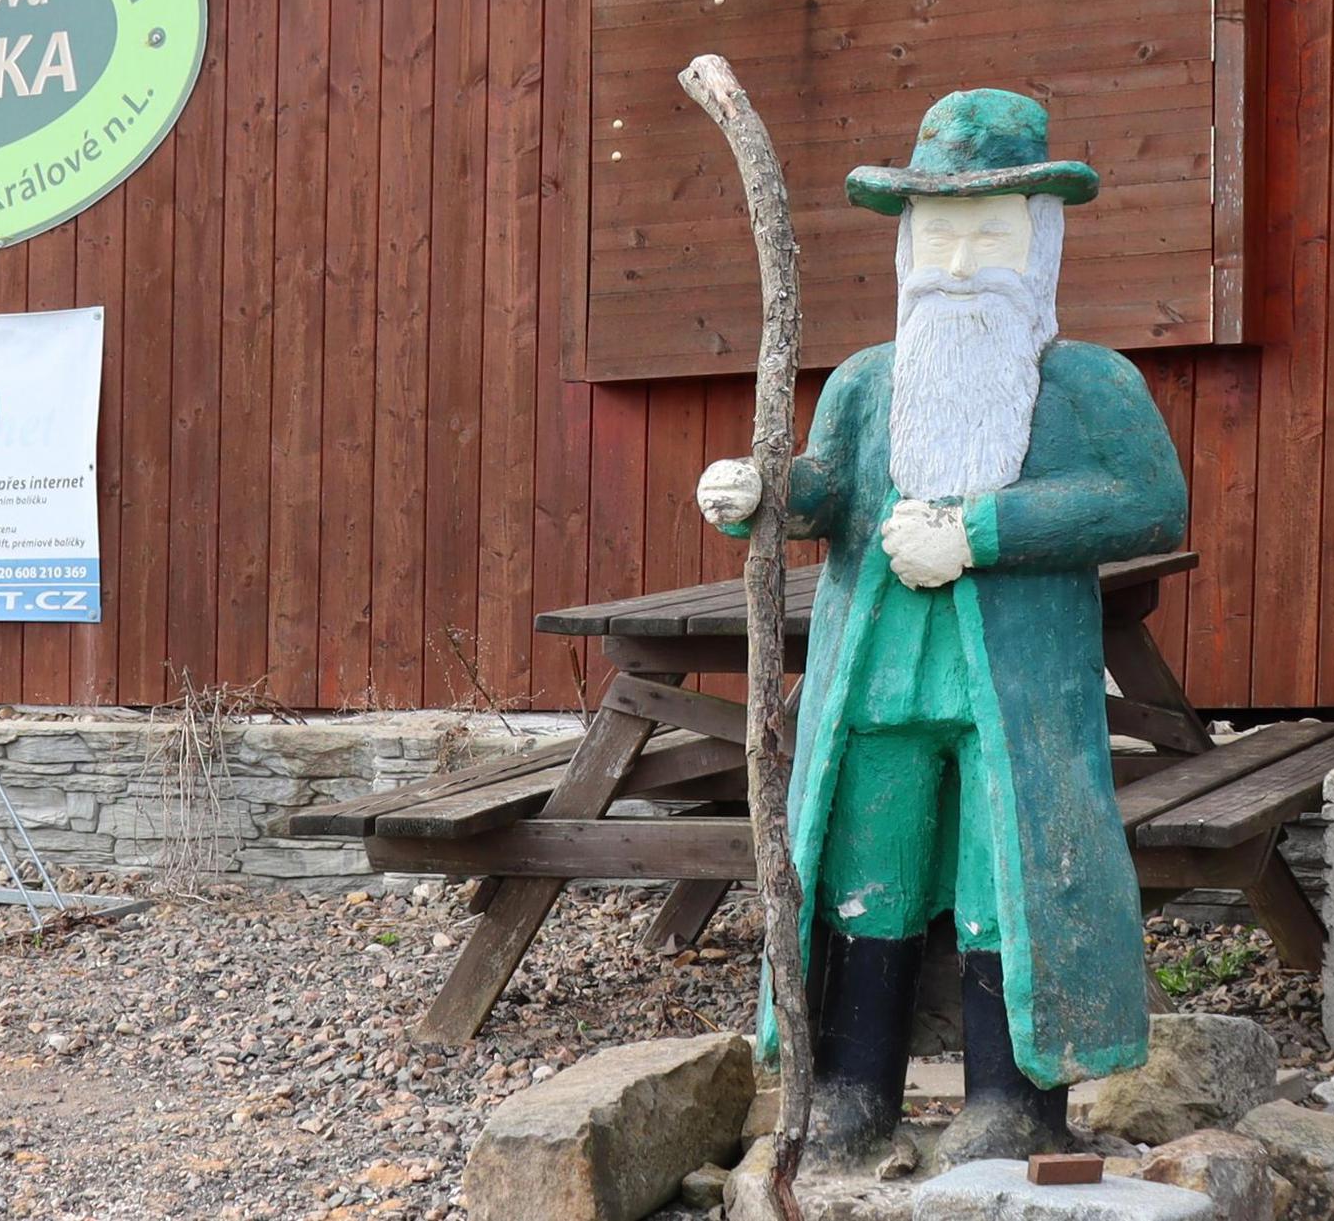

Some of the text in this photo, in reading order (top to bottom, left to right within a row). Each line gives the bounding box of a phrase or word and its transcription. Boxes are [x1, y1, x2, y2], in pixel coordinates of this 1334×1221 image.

[29, 475, 84, 489] internet
[15, 567, 37, 578] 608
[39, 566, 62, 578] 210
[64, 566, 87, 578] 369
